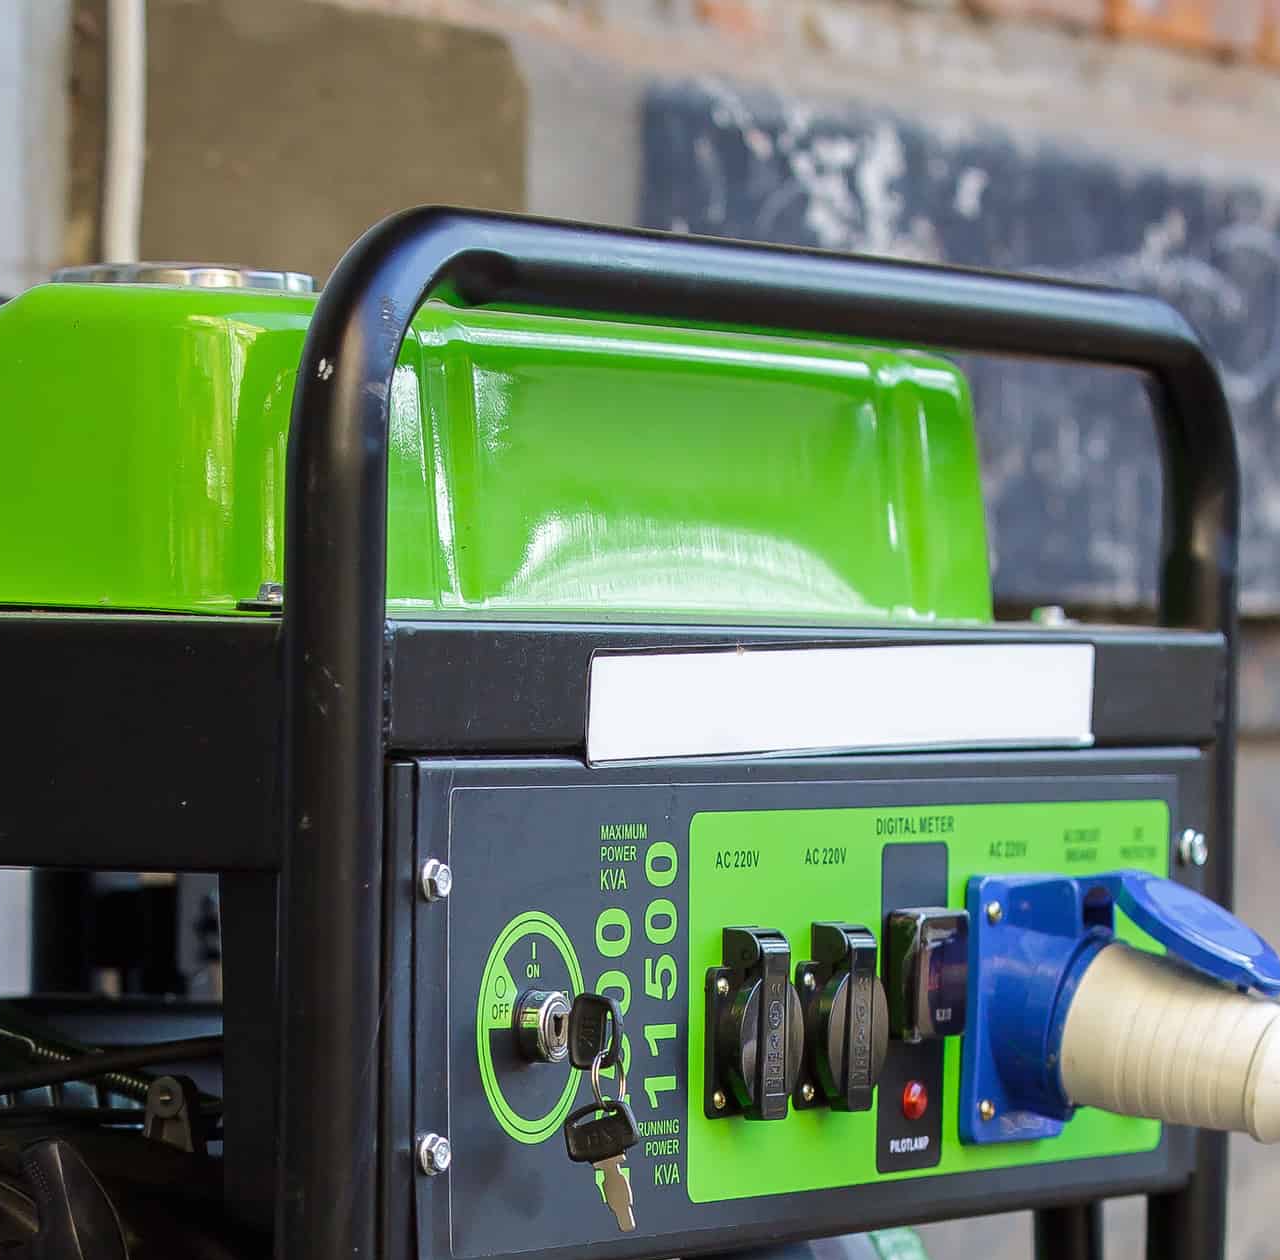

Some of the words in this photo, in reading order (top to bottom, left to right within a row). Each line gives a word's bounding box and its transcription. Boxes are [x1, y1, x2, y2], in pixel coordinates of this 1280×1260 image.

[600, 823, 648, 840] MAXIMUM
[876, 817, 917, 836] DIGITAL
[919, 815, 954, 834] METER
[600, 845, 637, 862] POWER
[715, 851, 731, 869] AC
[734, 850, 760, 868] 220V
[805, 848, 820, 865] AC
[823, 847, 847, 865] 220V
[600, 868, 627, 891] KVA
[526, 963, 540, 978] ON
[644, 841, 679, 1109] 11500
[492, 1003, 510, 1019] OFF
[638, 1118, 680, 1137] RUNNING
[646, 1139, 680, 1157] POWER
[654, 1162, 680, 1185] KVA
